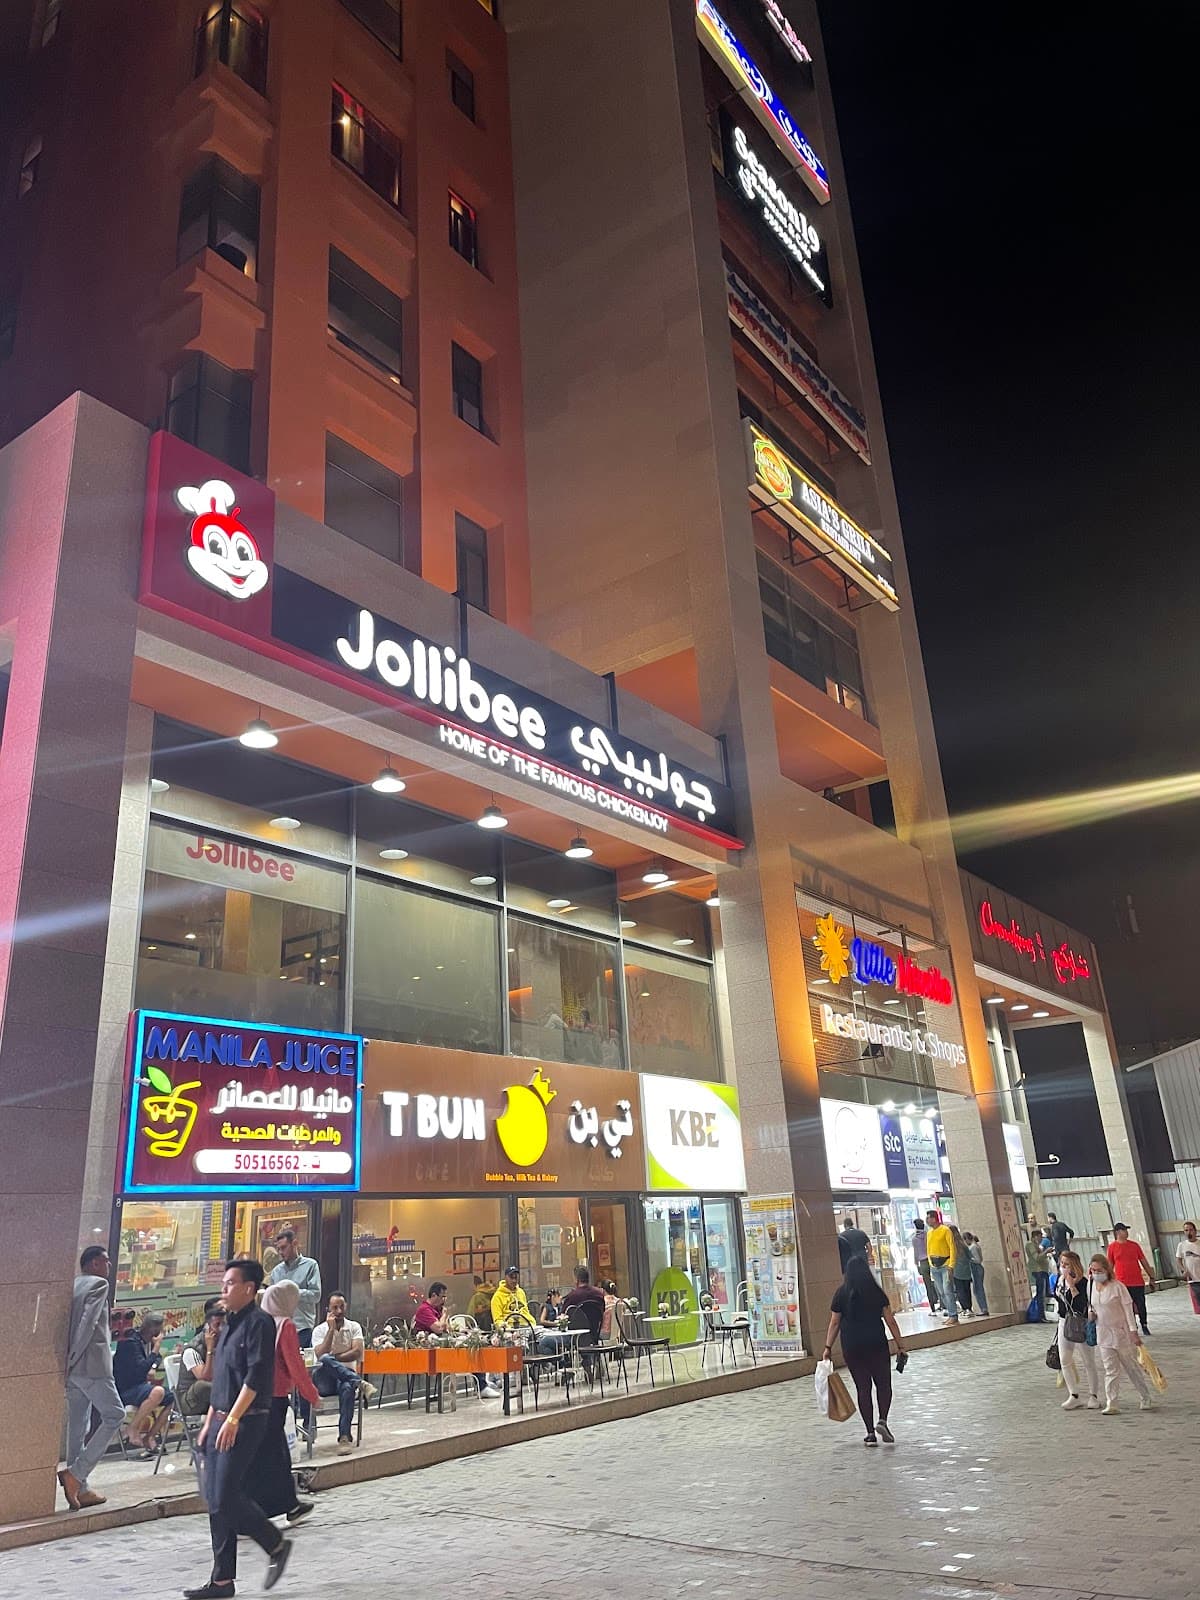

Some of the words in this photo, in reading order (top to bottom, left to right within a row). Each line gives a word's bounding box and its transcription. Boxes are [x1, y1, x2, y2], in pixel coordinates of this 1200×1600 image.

[801, 481, 840, 531] ASIA'S
[840, 518, 875, 563] GRILL
[336, 608, 546, 750] Jollibee
[440, 724, 487, 760] HOME
[488, 744, 510, 767] OF
[511, 752, 541, 782] THE
[541, 765, 598, 805] FAMOUS
[597, 785, 670, 833] CHICKENJOY
[570, 725, 716, 821] جوليبي
[186, 836, 295, 882] Jollibee
[146, 1025, 273, 1068] MANILA
[277, 1040, 356, 1076] JUICE
[820, 1003, 913, 1052] Restaurants
[915, 1029, 928, 1055] &
[928, 1031, 966, 1067] Shops
[209, 1079, 298, 1114] للعصائر
[298, 1086, 353, 1119] مانيلا
[382, 1090, 410, 1137] T
[415, 1094, 487, 1142] BUN
[220, 1121, 276, 1143] الصحية
[668, 1108, 720, 1148] KBE
[883, 1131, 902, 1152] stc
[485, 1172, 504, 1182] Bubble
[527, 1172, 536, 1182] Tea
[541, 1172, 559, 1183] Bakery
